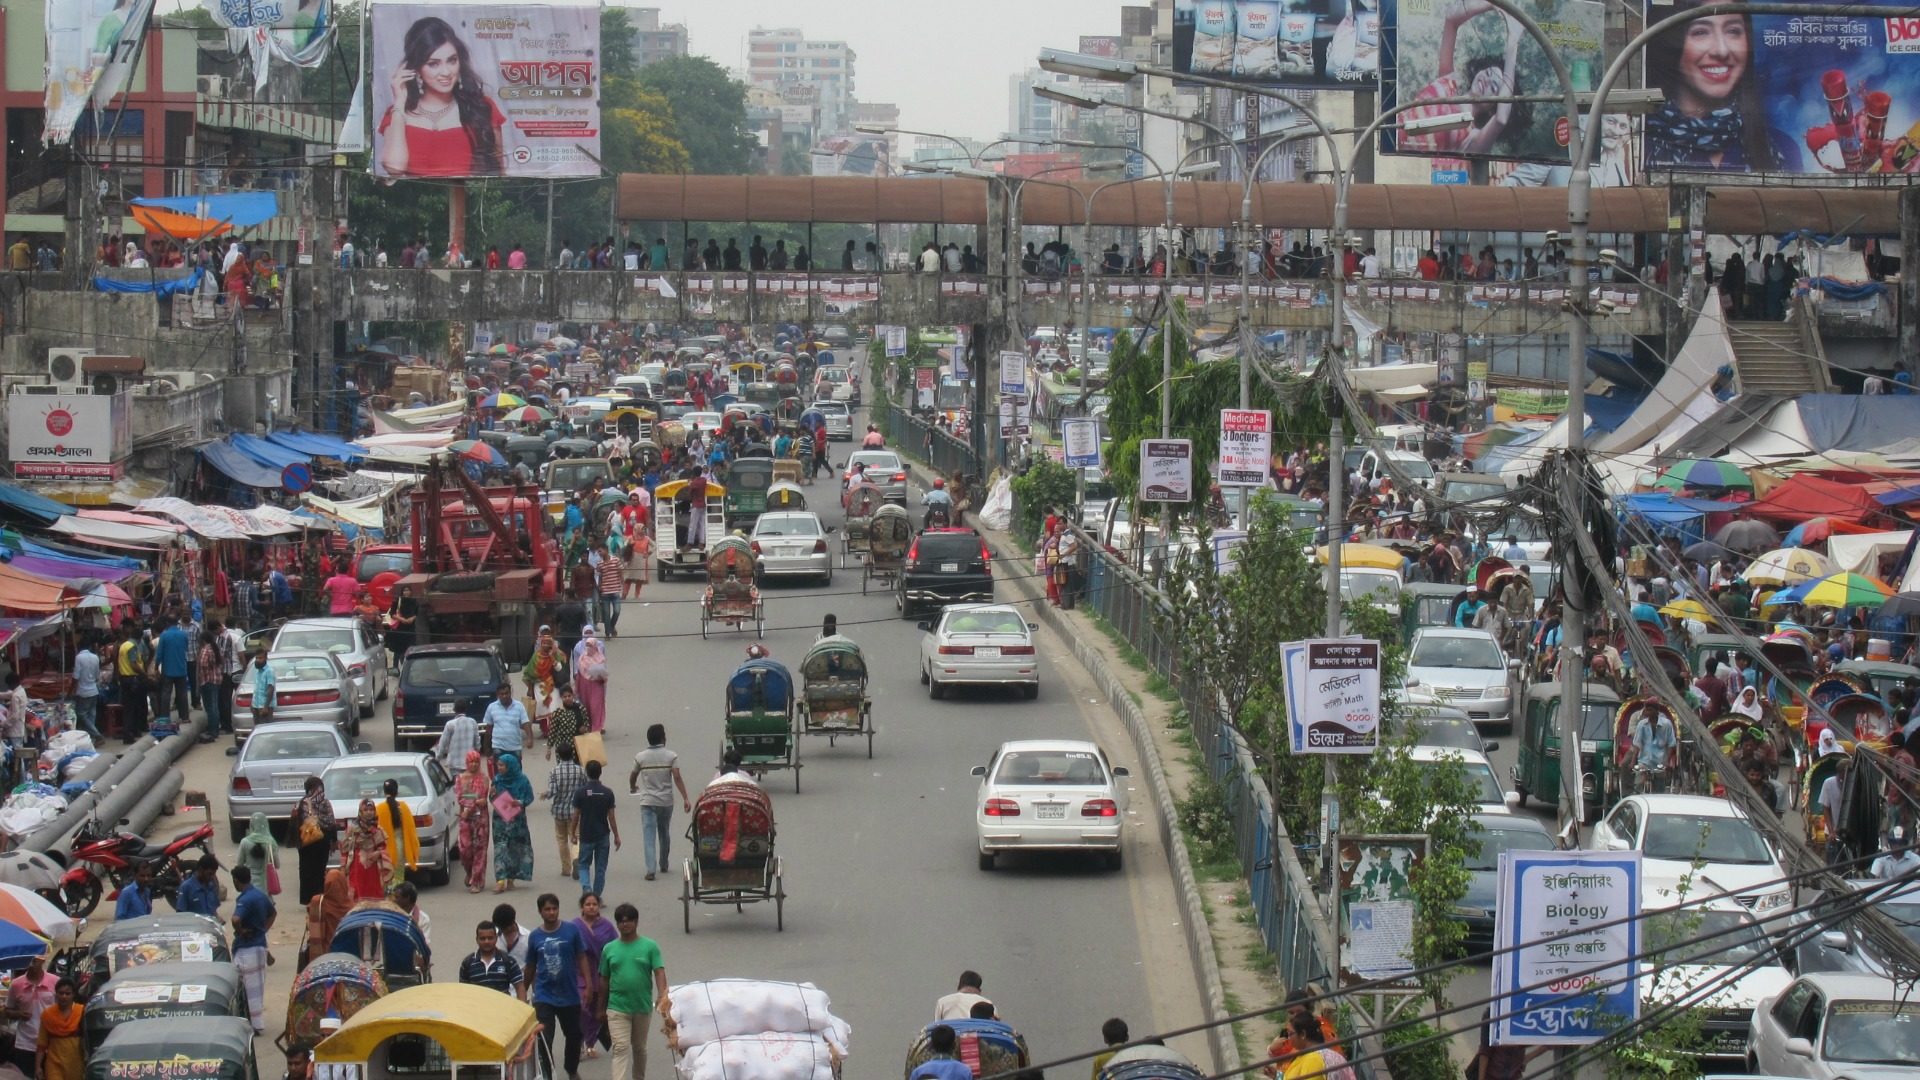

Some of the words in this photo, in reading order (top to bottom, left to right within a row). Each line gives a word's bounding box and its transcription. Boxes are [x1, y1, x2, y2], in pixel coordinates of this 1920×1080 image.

[1788, 18, 1823, 34] জীবন
[1840, 20, 1867, 33] রঙিন
[1764, 31, 1787, 46] হাসি
[500, 61, 592, 86] আপন
[26, 446, 57, 456] প্রথম
[58, 446, 92, 457] আলো
[1326, 647, 1343, 655] খোলা
[1344, 646, 1361, 656] থাকুক
[1314, 657, 1340, 666] সম্ভাবনার
[1341, 657, 1356, 665] সকল
[1358, 657, 1373, 667] দুয়ার
[1319, 673, 1361, 693] মেডিকেল
[1344, 694, 1364, 705] Math
[1309, 728, 1345, 747] উন্মেষ
[1542, 872, 1613, 890] ইঞ্জিনিয়ারিং
[1546, 904, 1608, 919] Biology
[1545, 943, 1570, 959] সুদৃঢ়
[1574, 939, 1606, 955] প্রস্তুতি
[1512, 998, 1593, 1035] উদ্ভাস
[110, 1060, 158, 1079] মহান
